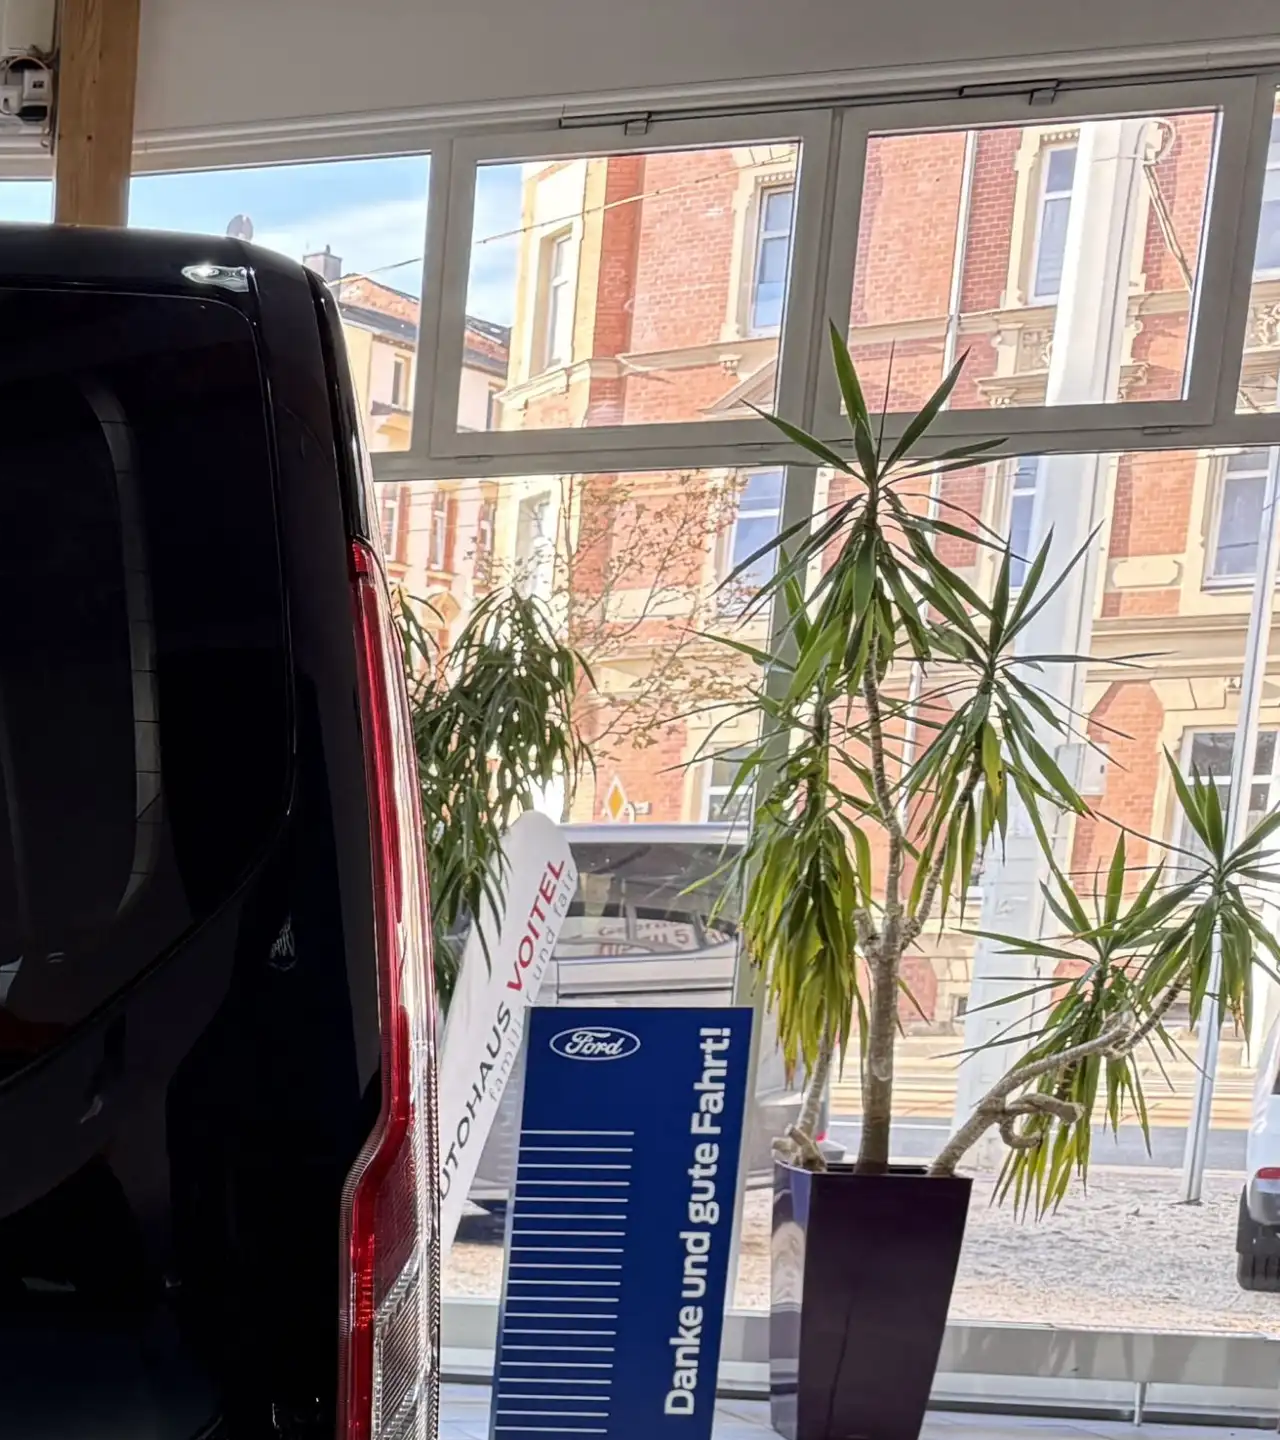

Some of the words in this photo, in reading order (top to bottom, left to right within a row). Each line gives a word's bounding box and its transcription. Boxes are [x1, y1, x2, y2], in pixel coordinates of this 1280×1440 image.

[507, 858, 565, 991] VOITEL
[489, 989, 533, 1102] familir
[532, 925, 556, 981] und
[553, 869, 576, 917] fair
[564, 1031, 626, 1057] Ford
[690, 1027, 732, 1135] Fahrt!
[688, 1142, 720, 1225] gute
[678, 1231, 712, 1299] und
[663, 1306, 704, 1416] Danke
